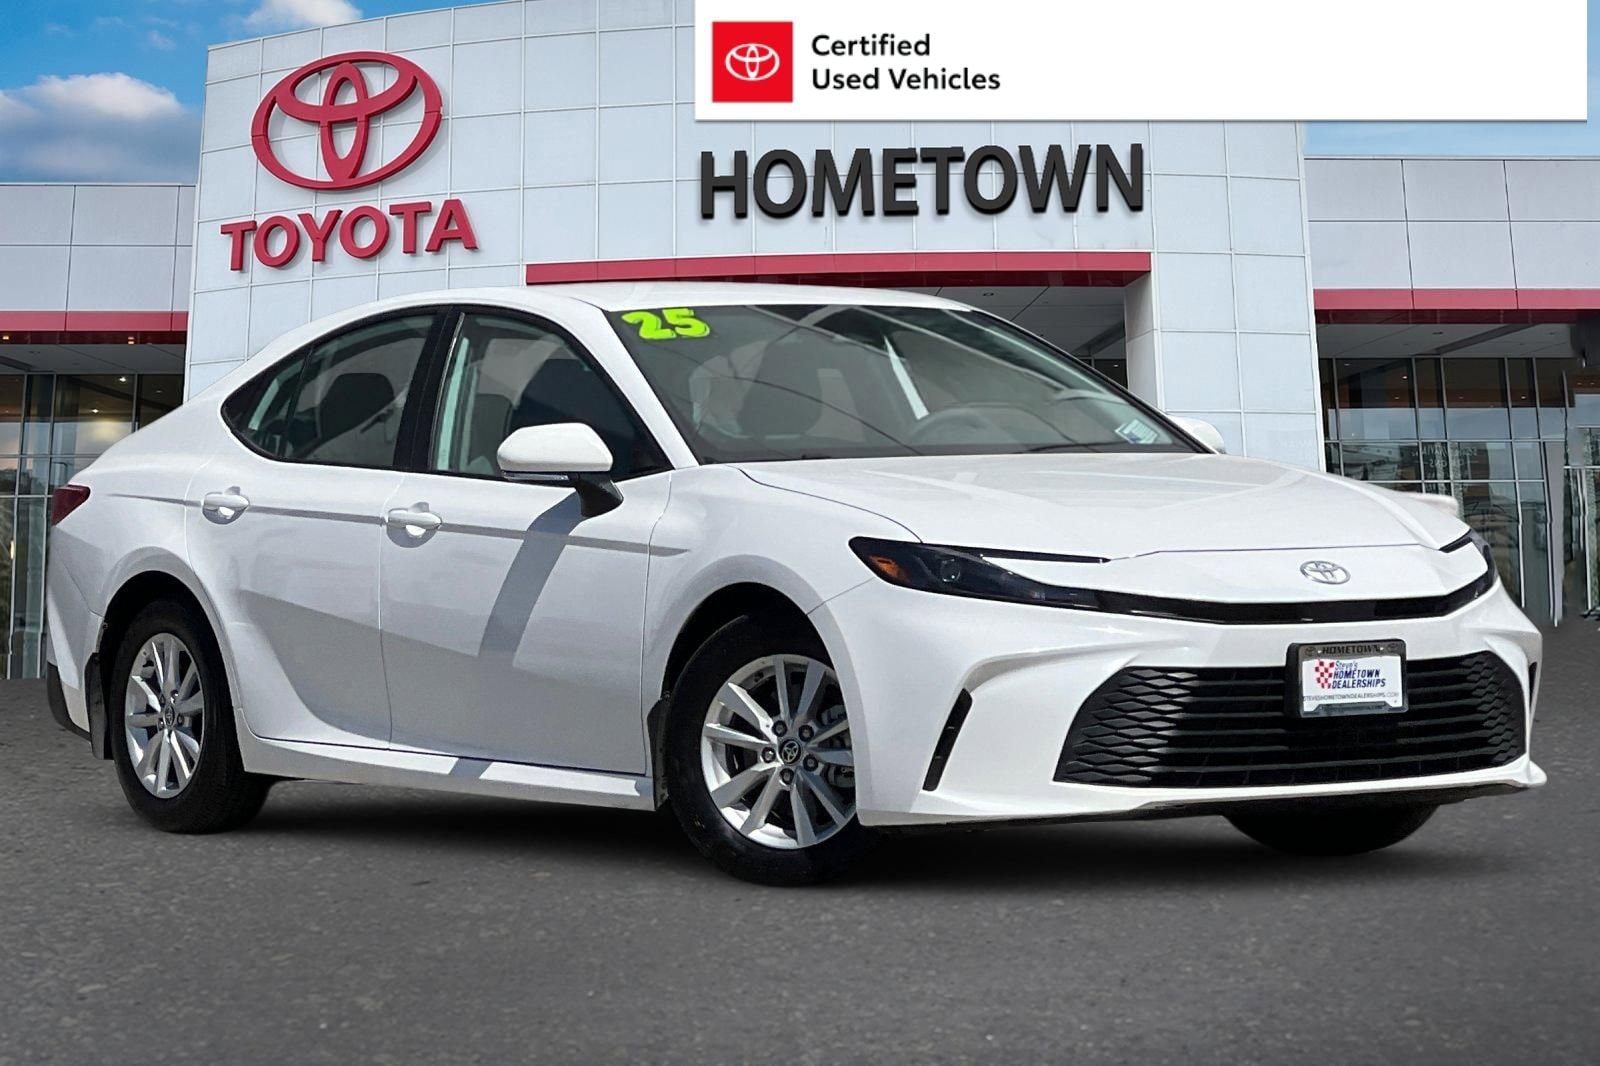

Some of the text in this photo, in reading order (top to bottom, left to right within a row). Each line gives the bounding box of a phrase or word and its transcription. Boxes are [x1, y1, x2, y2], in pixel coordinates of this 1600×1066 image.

[700, 143, 1144, 219] HOMETOWN
[220, 198, 478, 271] TOYOTA
[621, 307, 710, 341] 25
[1322, 644, 1381, 654] HOMETOWN
[1335, 660, 1358, 671] Steve's
[1333, 669, 1380, 680] HOMETOWN
[1332, 678, 1386, 689] DEALERSHIPS
